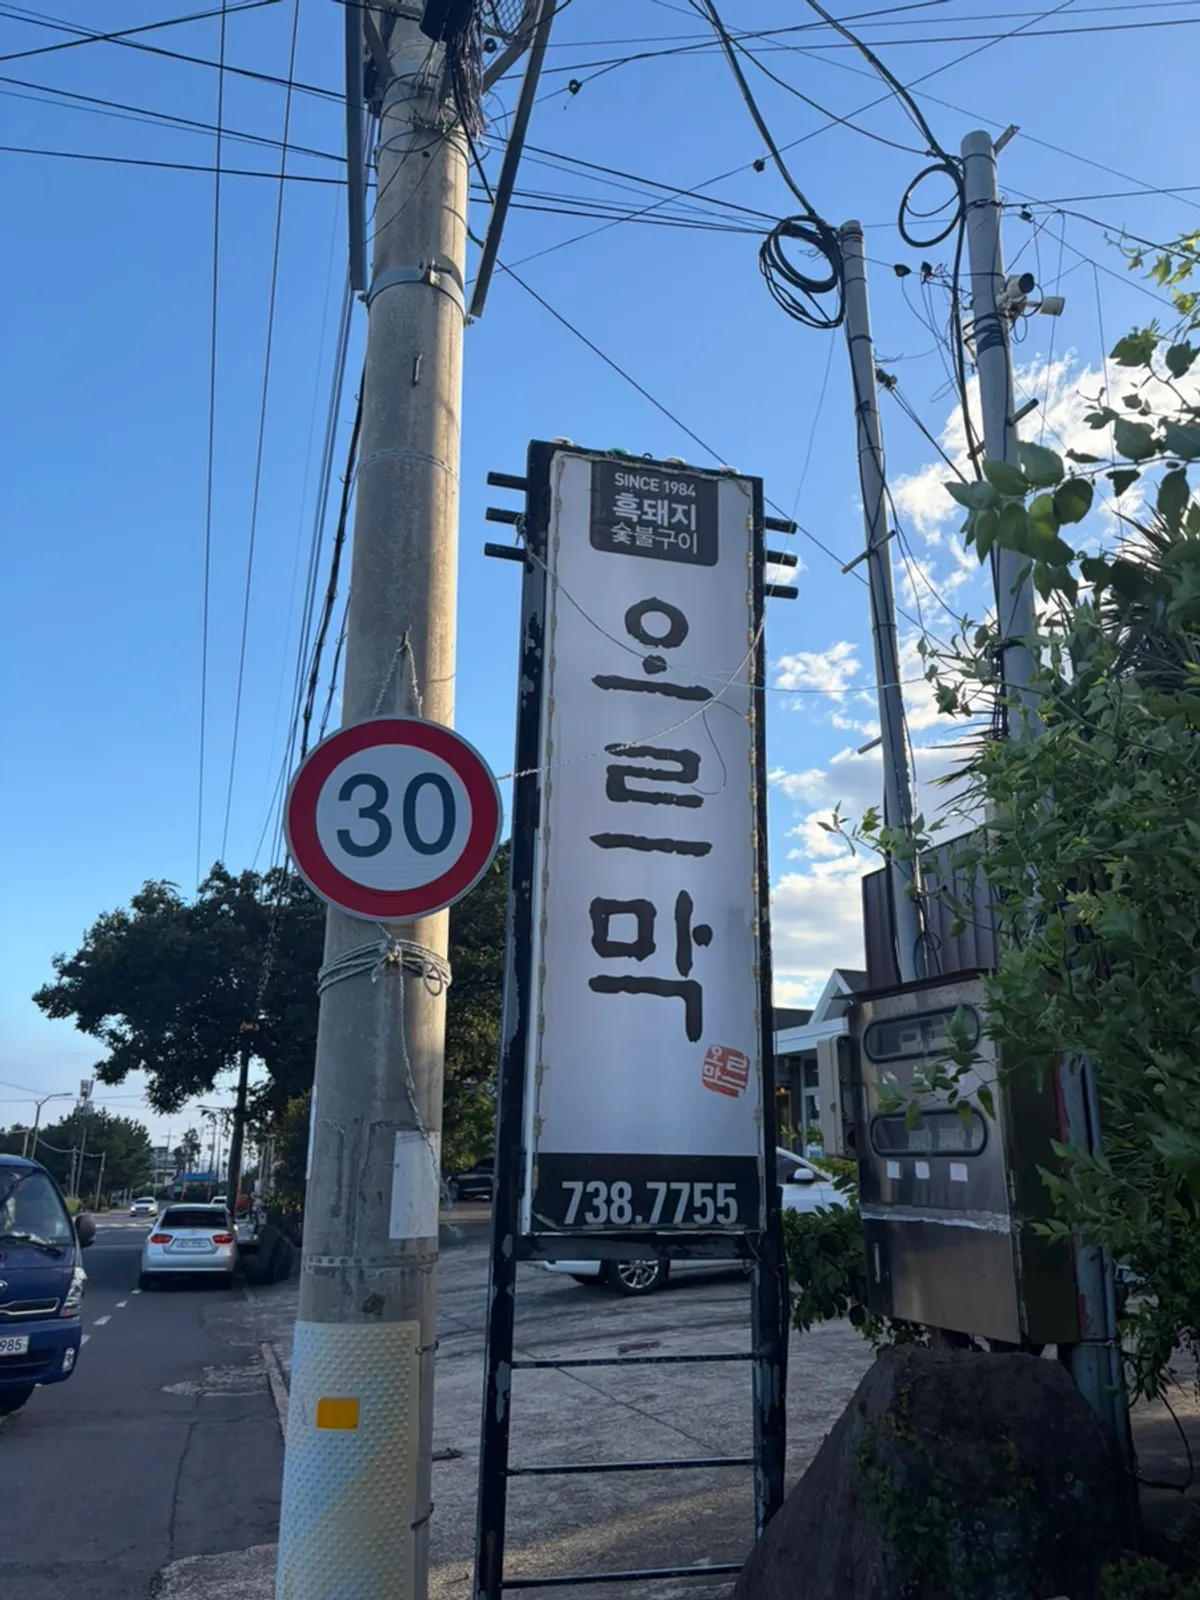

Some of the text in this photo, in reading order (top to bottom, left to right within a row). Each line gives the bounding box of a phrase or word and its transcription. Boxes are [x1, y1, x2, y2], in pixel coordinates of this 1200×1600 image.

[614, 472, 696, 497] SINCE 1984
[612, 492, 697, 531] 흑돼지
[611, 521, 698, 554] 숯불구이
[336, 772, 456, 858] 30
[588, 596, 714, 1043] 오르막
[561, 1180, 739, 1225] 738.7755
